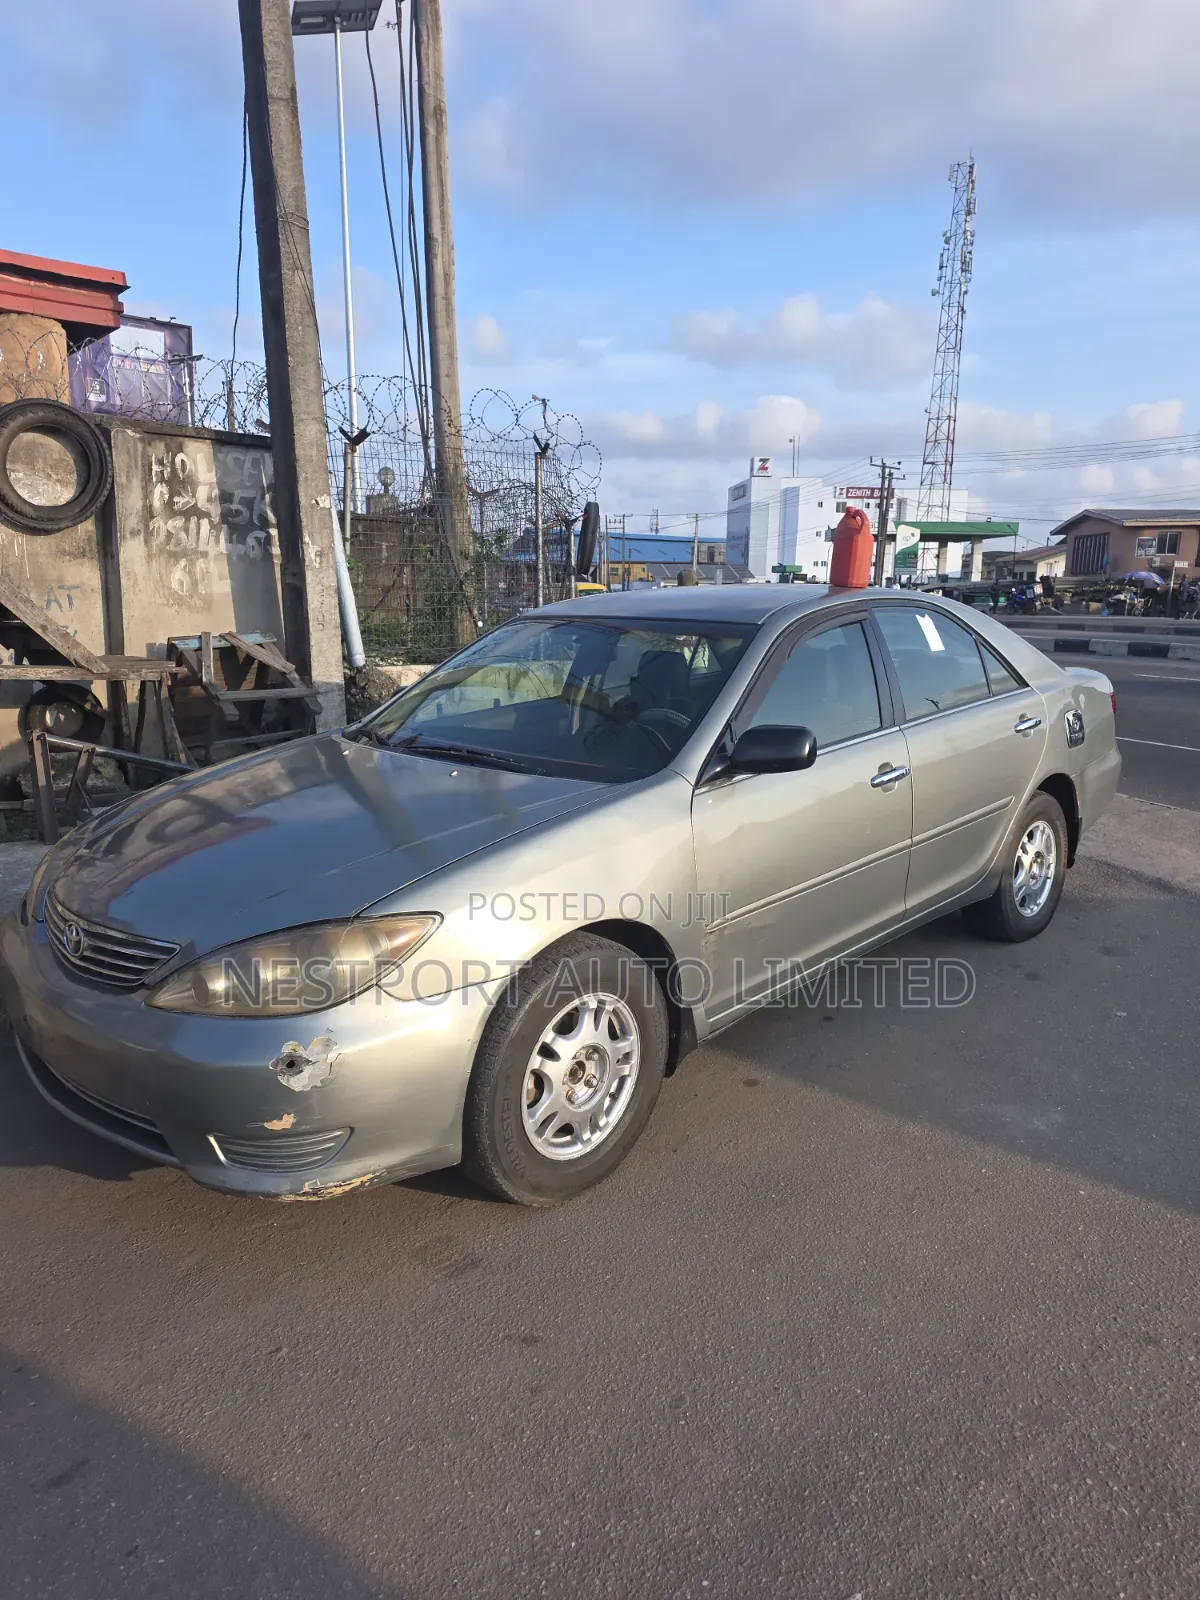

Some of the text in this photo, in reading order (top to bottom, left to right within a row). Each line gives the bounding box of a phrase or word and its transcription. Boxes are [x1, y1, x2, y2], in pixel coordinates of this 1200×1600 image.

[152, 452, 261, 486] HOUSE
[847, 488, 871, 498] ZENITH
[45, 583, 85, 612] AT
